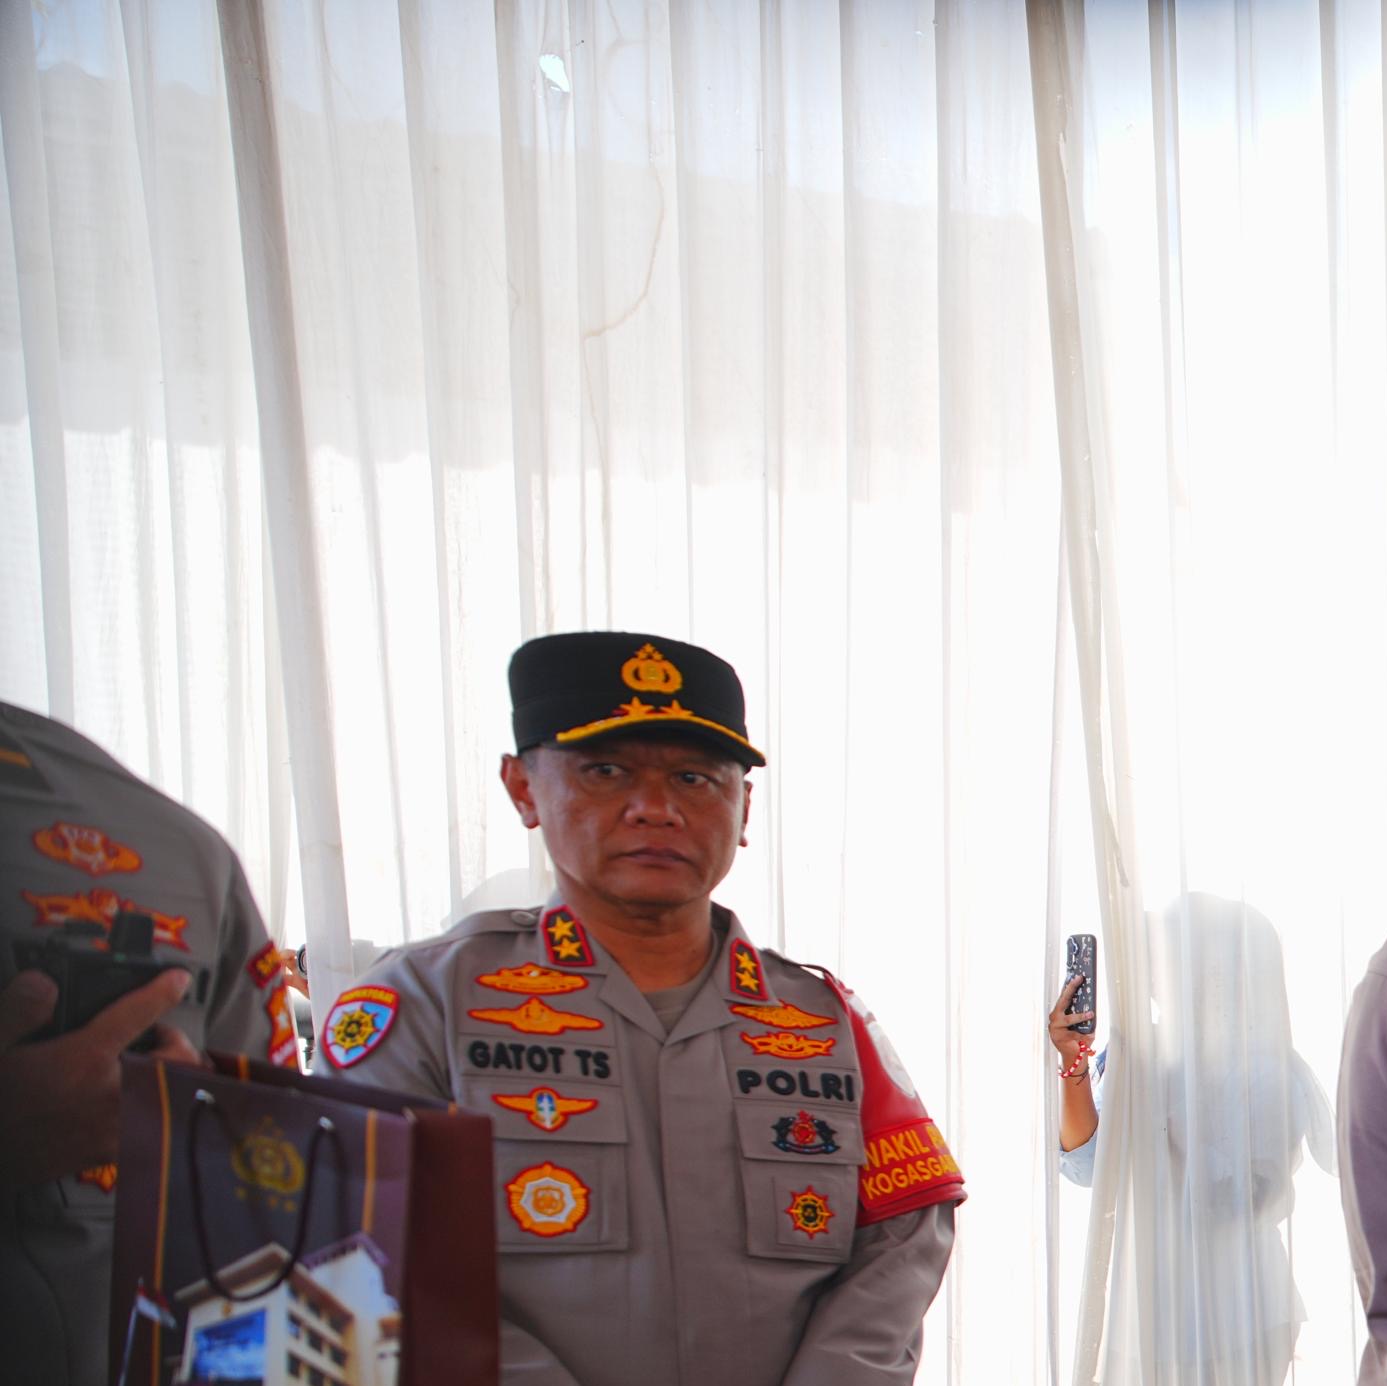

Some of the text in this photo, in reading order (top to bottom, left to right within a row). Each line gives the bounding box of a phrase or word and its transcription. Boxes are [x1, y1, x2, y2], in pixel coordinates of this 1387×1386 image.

[468, 1040, 611, 1079] GATOT TS
[736, 1068, 856, 1102] POLRI
[863, 1129, 930, 1171] WAKIL
